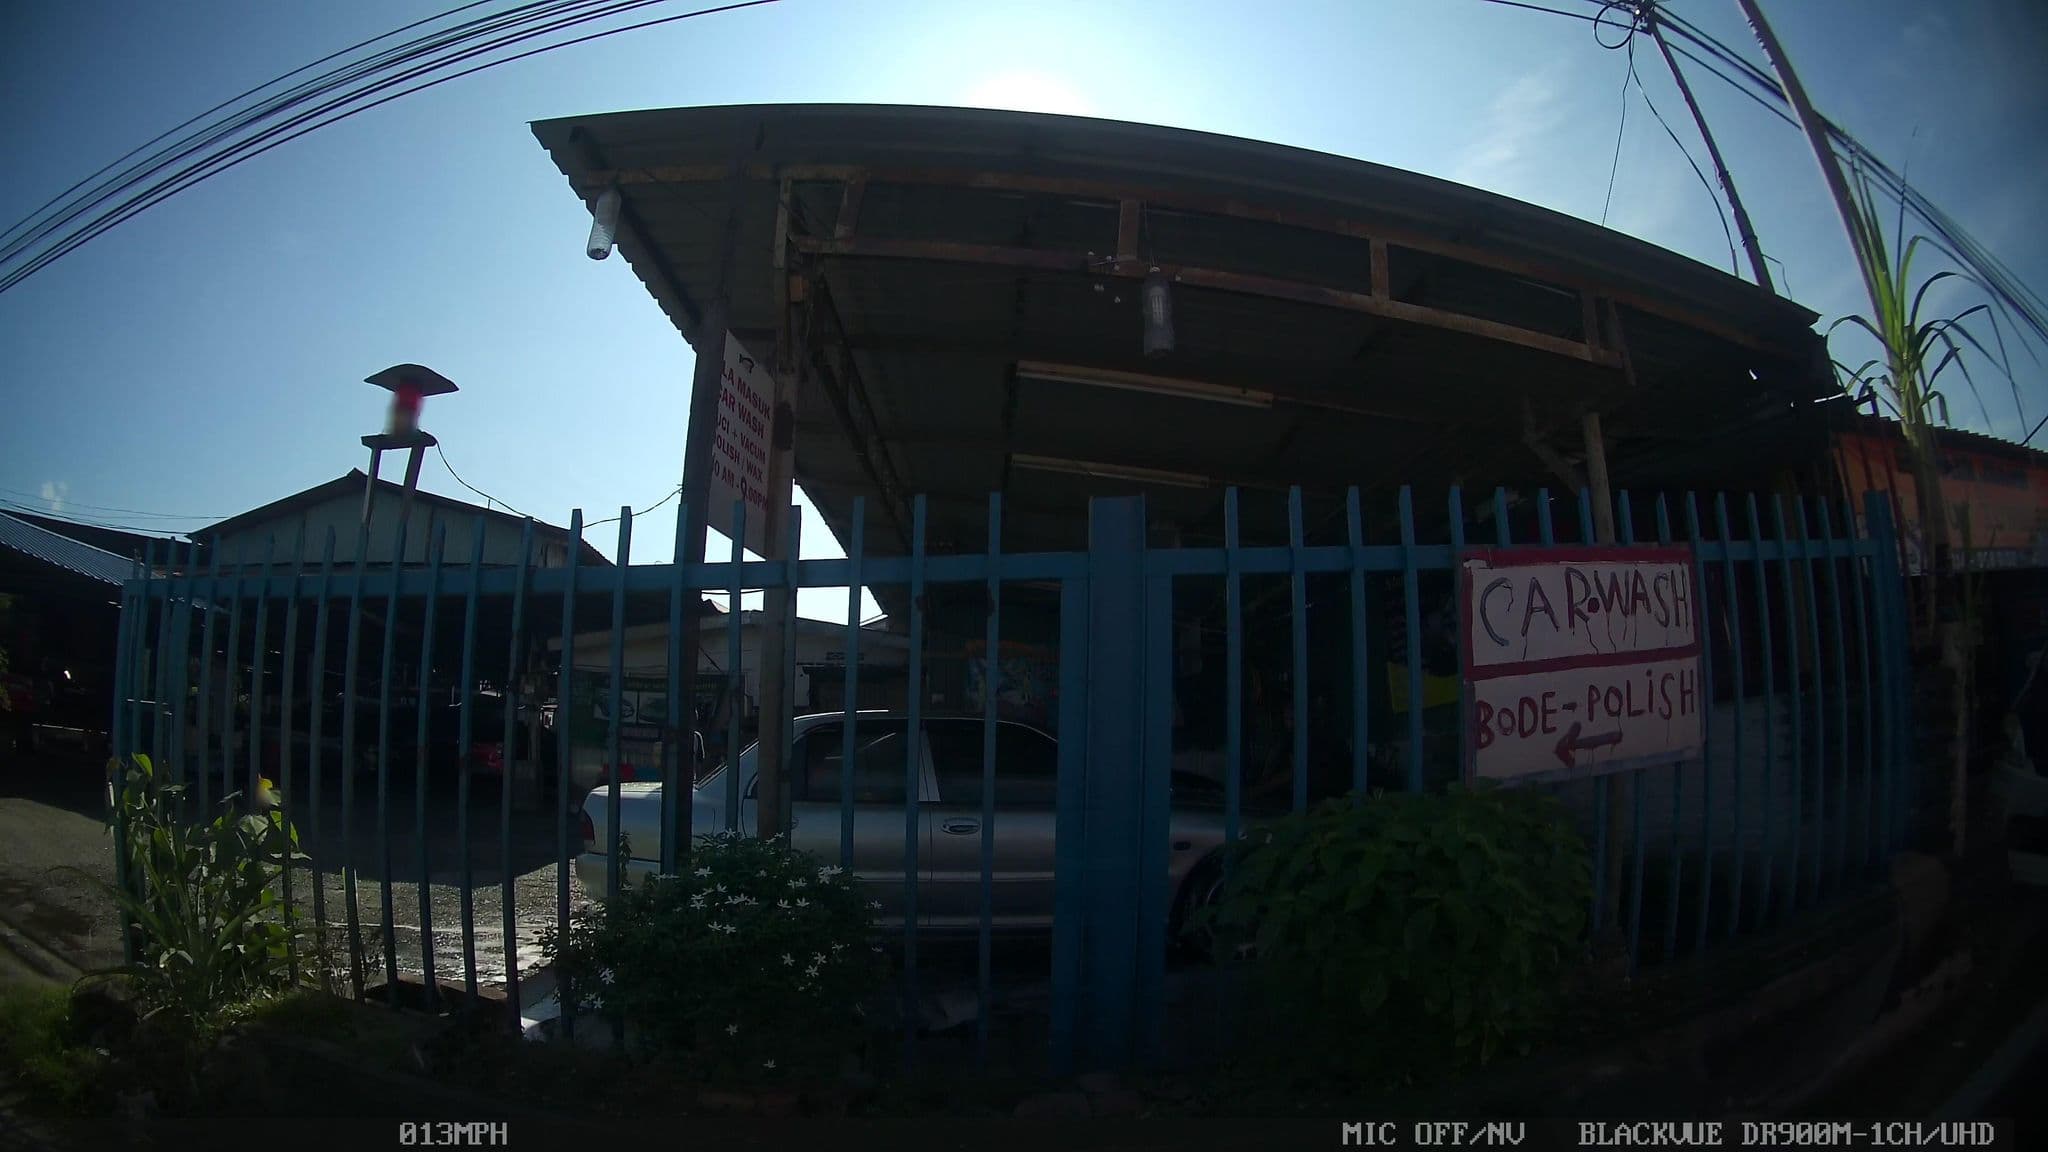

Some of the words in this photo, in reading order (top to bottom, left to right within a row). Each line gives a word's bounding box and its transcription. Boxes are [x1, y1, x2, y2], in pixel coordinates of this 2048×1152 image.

[719, 387, 735, 412] AR
[738, 402, 765, 439] WASH
[720, 367, 734, 386] LA
[737, 376, 770, 419] MASUK
[715, 433, 740, 465] OLISH
[746, 457, 763, 483] WAX
[740, 432, 766, 465] VACUM
[721, 466, 735, 488] AM
